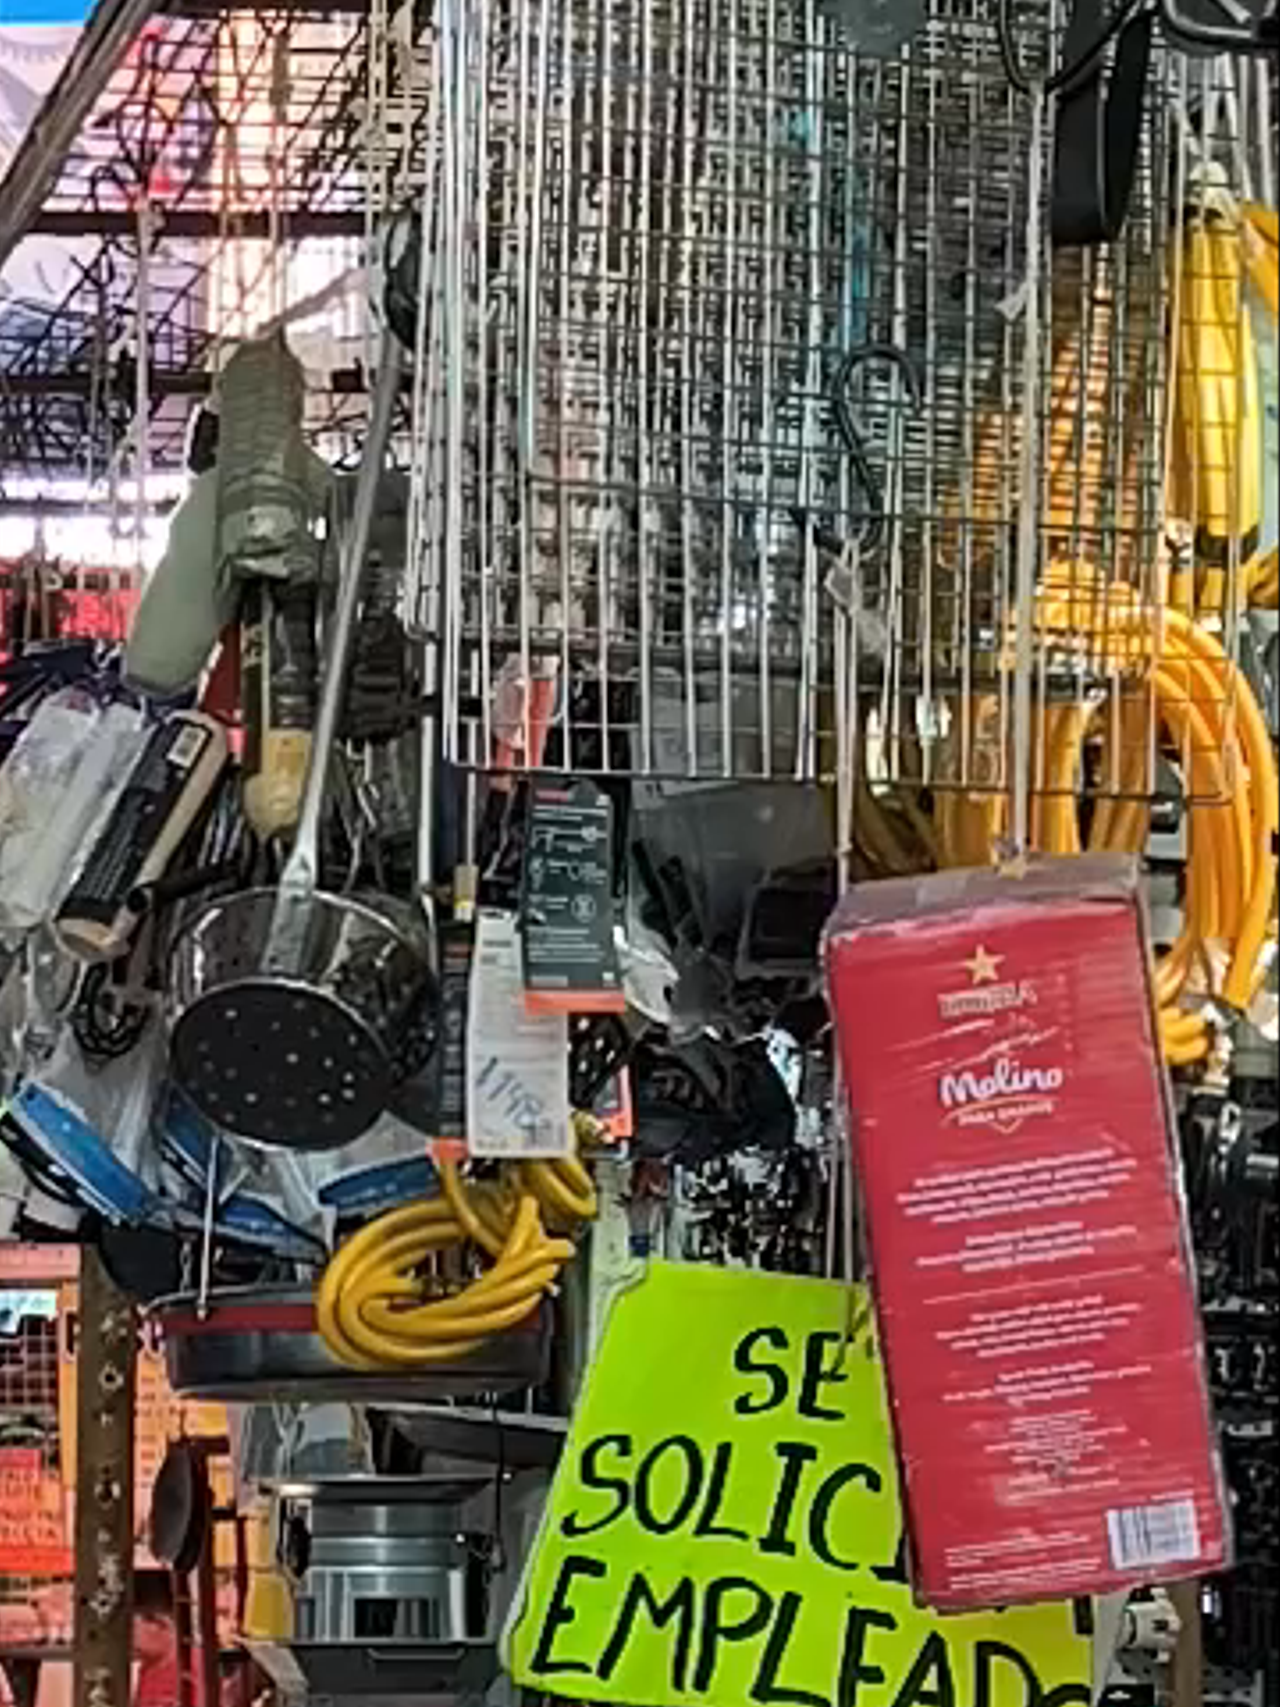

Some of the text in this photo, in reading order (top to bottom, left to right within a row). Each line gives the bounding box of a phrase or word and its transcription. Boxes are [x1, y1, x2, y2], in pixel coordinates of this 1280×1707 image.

[940, 1058, 1064, 1108] Molino
[733, 1327, 848, 1421] SE
[560, 1433, 980, 1593] SOLIC
